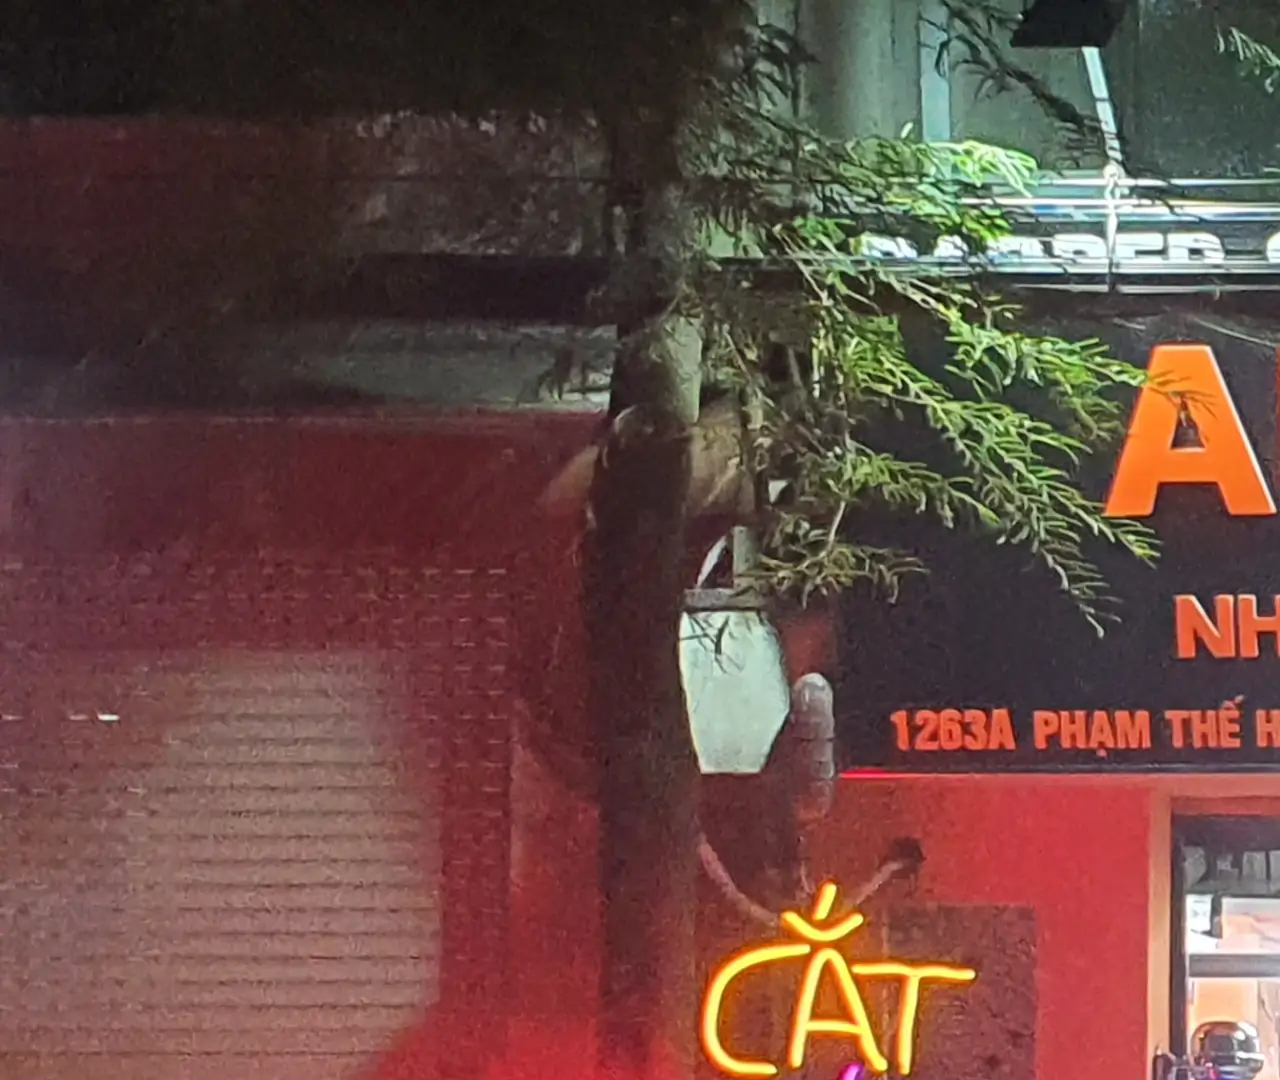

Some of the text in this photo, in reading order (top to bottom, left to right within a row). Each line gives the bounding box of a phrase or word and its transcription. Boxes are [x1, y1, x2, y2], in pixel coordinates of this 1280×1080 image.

[891, 708, 1016, 751] 1263A
[1034, 709, 1151, 755] PHẠM
[1165, 695, 1243, 749] THẾ
[703, 881, 977, 1076] CẮT
